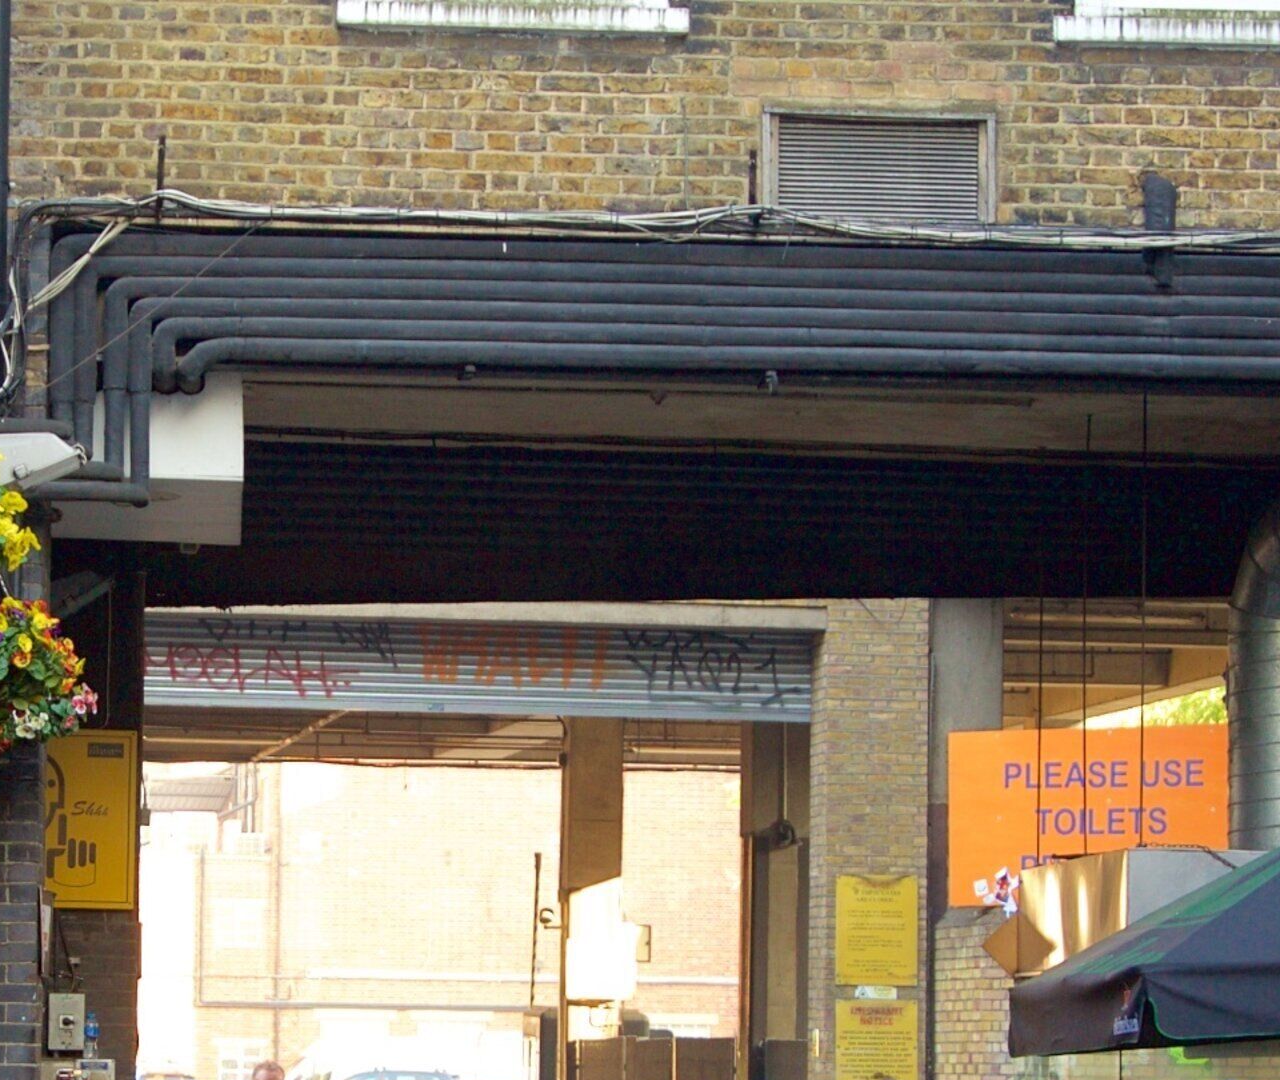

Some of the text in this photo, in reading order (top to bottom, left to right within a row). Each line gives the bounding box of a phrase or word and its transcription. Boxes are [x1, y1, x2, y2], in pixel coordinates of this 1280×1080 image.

[1004, 759, 1205, 789] PLEASE USE
[1035, 806, 1168, 836] TOILETS
